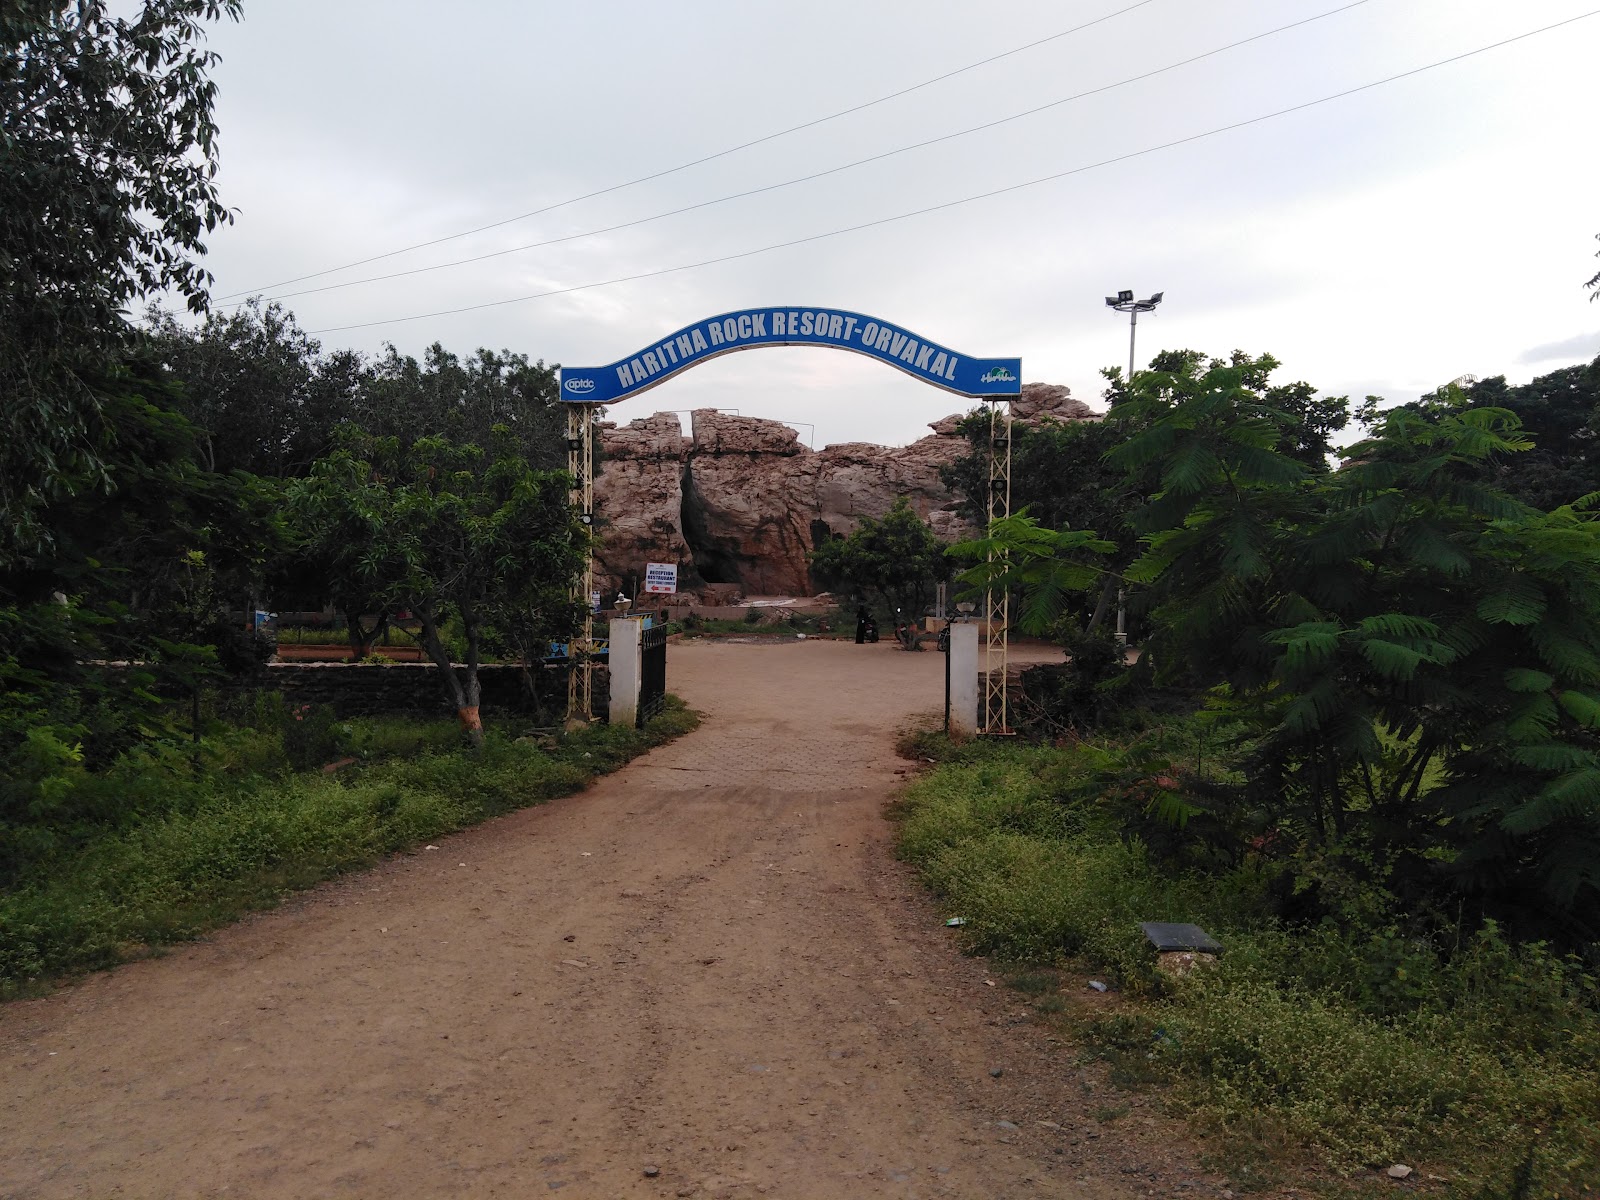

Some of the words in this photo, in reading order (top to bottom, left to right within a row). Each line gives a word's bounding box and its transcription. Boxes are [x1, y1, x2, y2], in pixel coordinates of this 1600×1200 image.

[615, 328, 707, 388] HARITHA
[708, 312, 767, 345] ROCK
[772, 312, 959, 381] RESORT-ORVAKAL
[568, 378, 595, 391] aptdc
